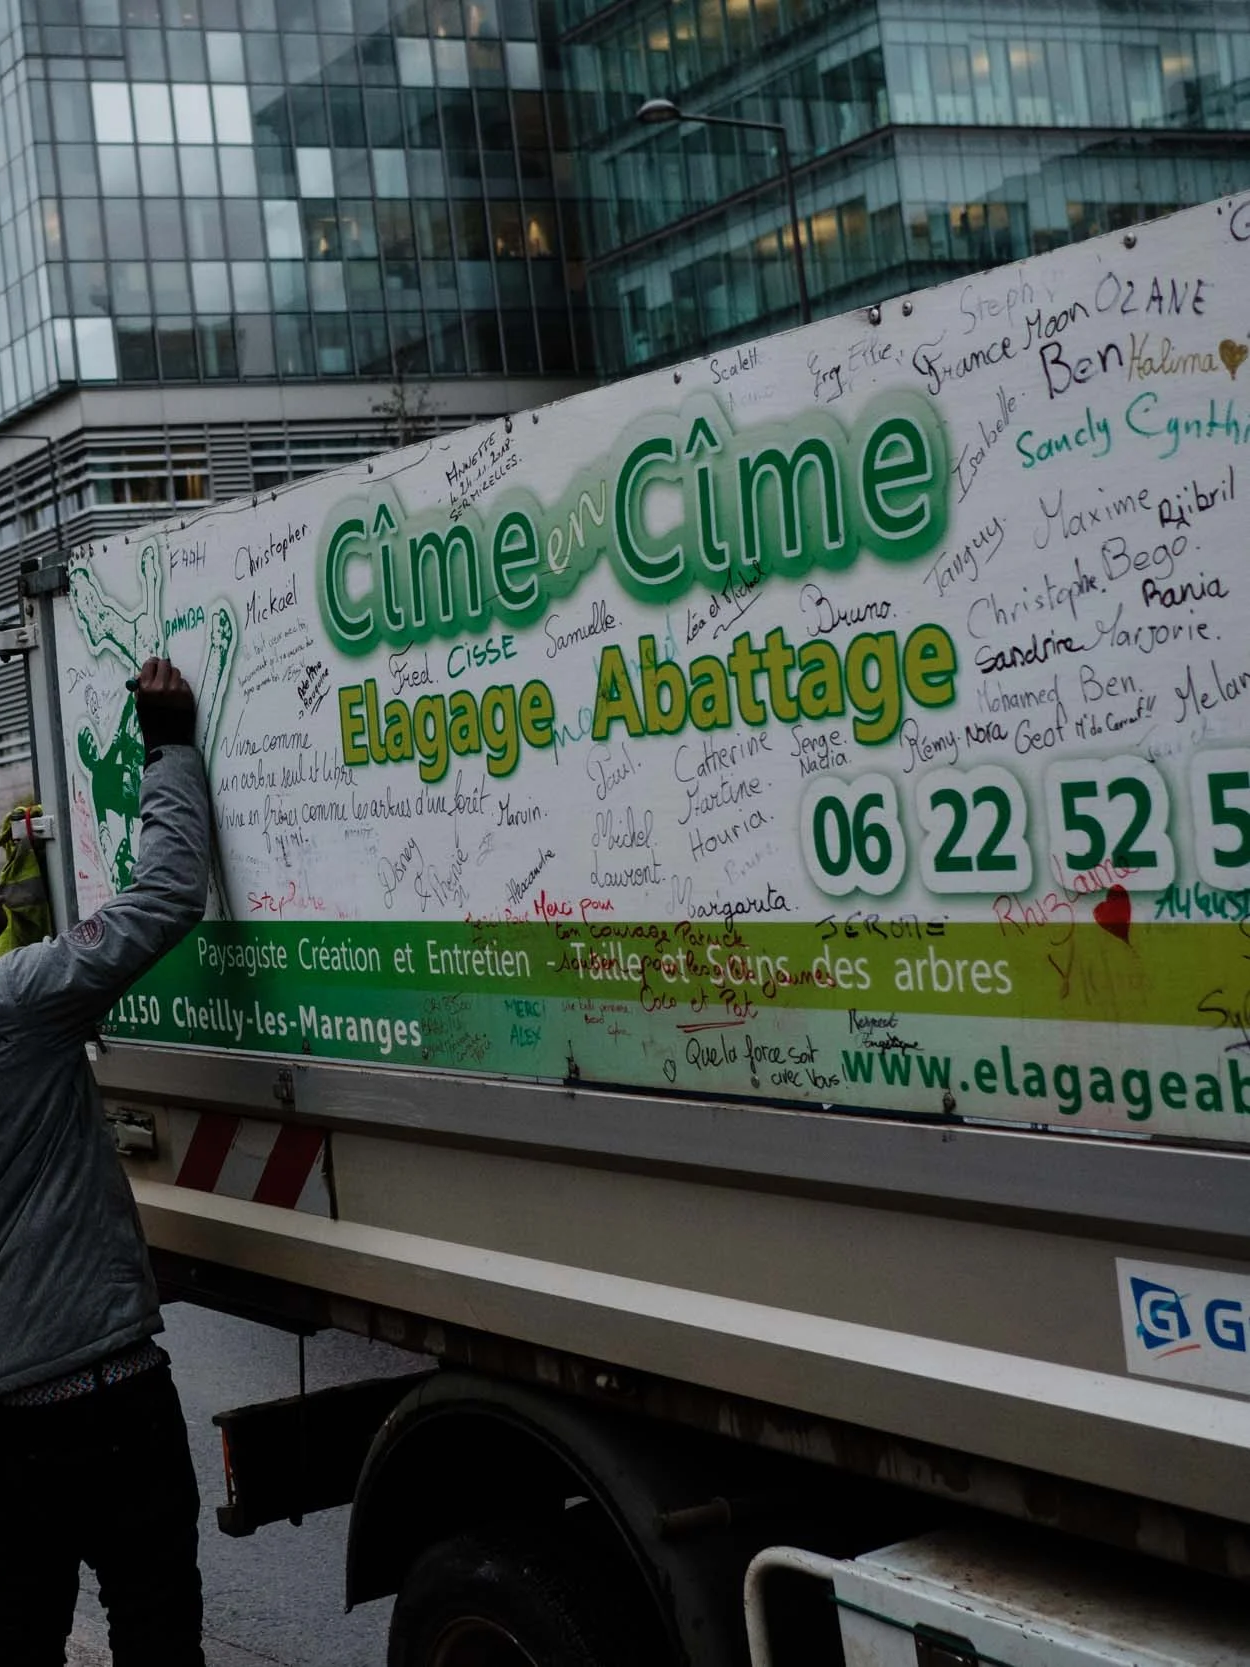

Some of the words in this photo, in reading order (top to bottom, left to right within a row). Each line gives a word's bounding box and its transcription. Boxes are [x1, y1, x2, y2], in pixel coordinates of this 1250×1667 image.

[1040, 341, 1124, 399] Ben
[325, 503, 539, 641] Cîme
[547, 480, 606, 575] en
[614, 416, 934, 585] Cîme
[338, 677, 555, 783] Elagage
[592, 622, 958, 746] Abattage
[813, 792, 892, 876] 06
[930, 786, 1017, 872] 22
[1060, 777, 1158, 871] 52
[197, 935, 287, 977] Paysagiste
[298, 935, 381, 972] Création
[393, 950, 415, 974] et
[426, 938, 531, 977] Entretien
[570, 941, 643, 982] Taille
[812, 943, 871, 990] des
[895, 945, 1013, 995] arbres
[172, 996, 422, 1054] Cheilly-les-Maranges
